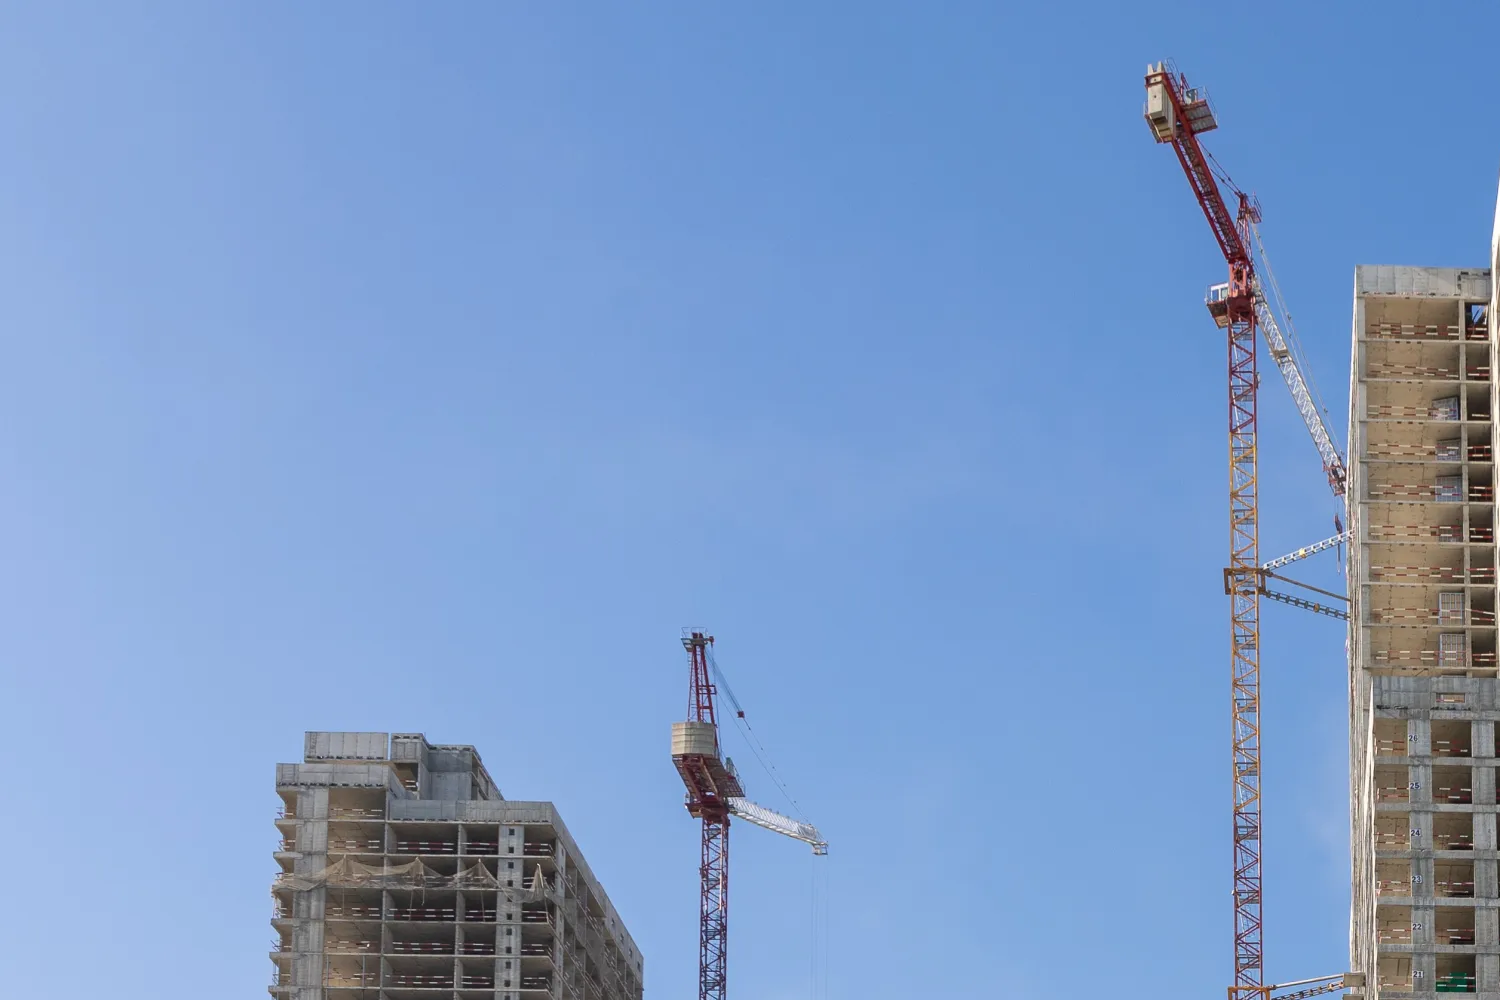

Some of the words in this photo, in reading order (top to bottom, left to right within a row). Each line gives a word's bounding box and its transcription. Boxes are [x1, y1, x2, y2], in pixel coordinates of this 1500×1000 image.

[1408, 734, 1418, 742] 26
[1409, 782, 1420, 790] 25
[1410, 829, 1421, 837] 24
[1411, 875, 1422, 883] 23
[1412, 923, 1422, 931] 22
[1413, 970, 1423, 978] 21
